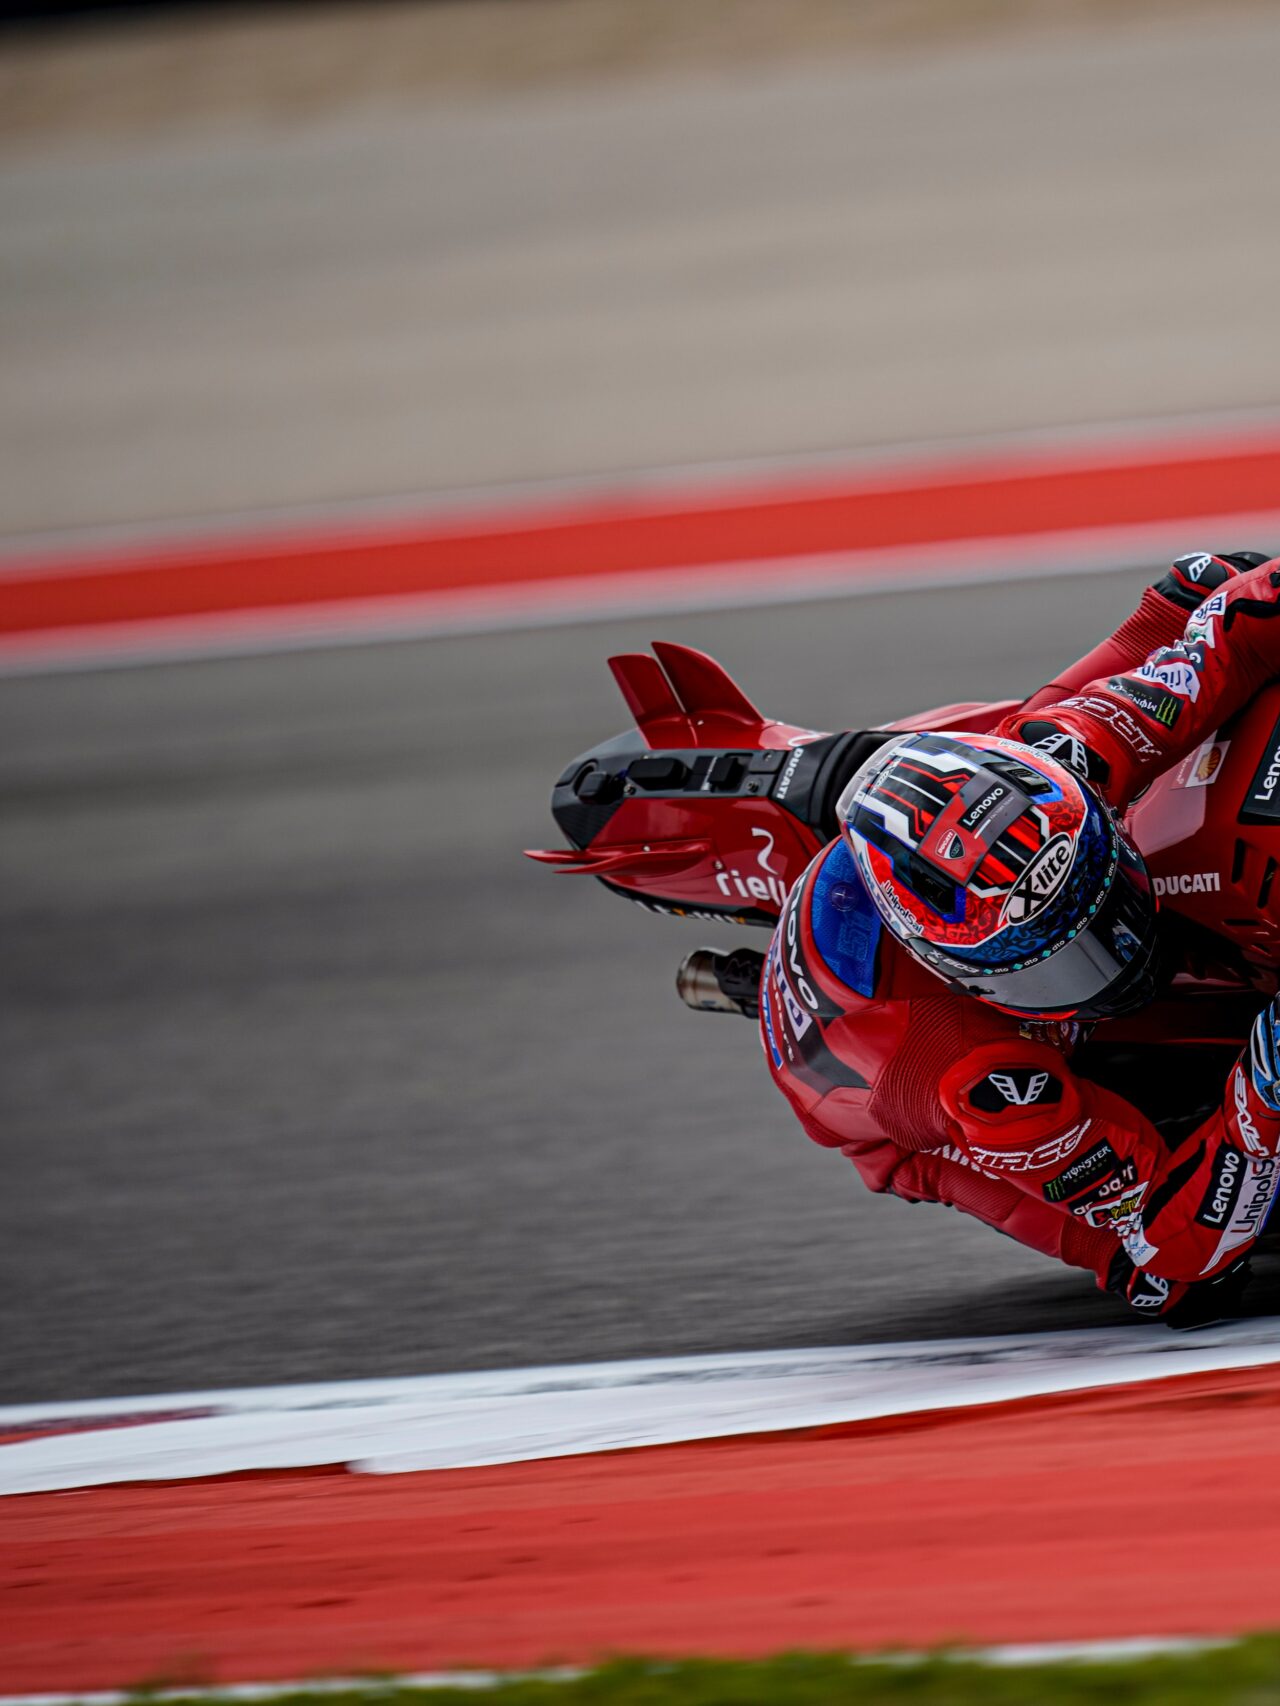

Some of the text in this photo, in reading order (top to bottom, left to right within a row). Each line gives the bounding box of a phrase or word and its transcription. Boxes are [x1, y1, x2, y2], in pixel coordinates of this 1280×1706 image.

[777, 748, 804, 800] DUCATI
[963, 788, 1004, 826] Lenovo
[937, 832, 954, 855] DUCATI
[715, 869, 788, 908] riell
[1008, 845, 1070, 923] X-lite
[1095, 890, 1105, 905] dto
[1152, 872, 1221, 897] DUCATI
[1076, 916, 1089, 931] dto
[1024, 957, 1039, 967] dto
[1052, 940, 1066, 952] dto
[1062, 1145, 1112, 1183] MONSTER
[1203, 1151, 1241, 1224] Lenovo
[1229, 1159, 1276, 1234] UnipolS
